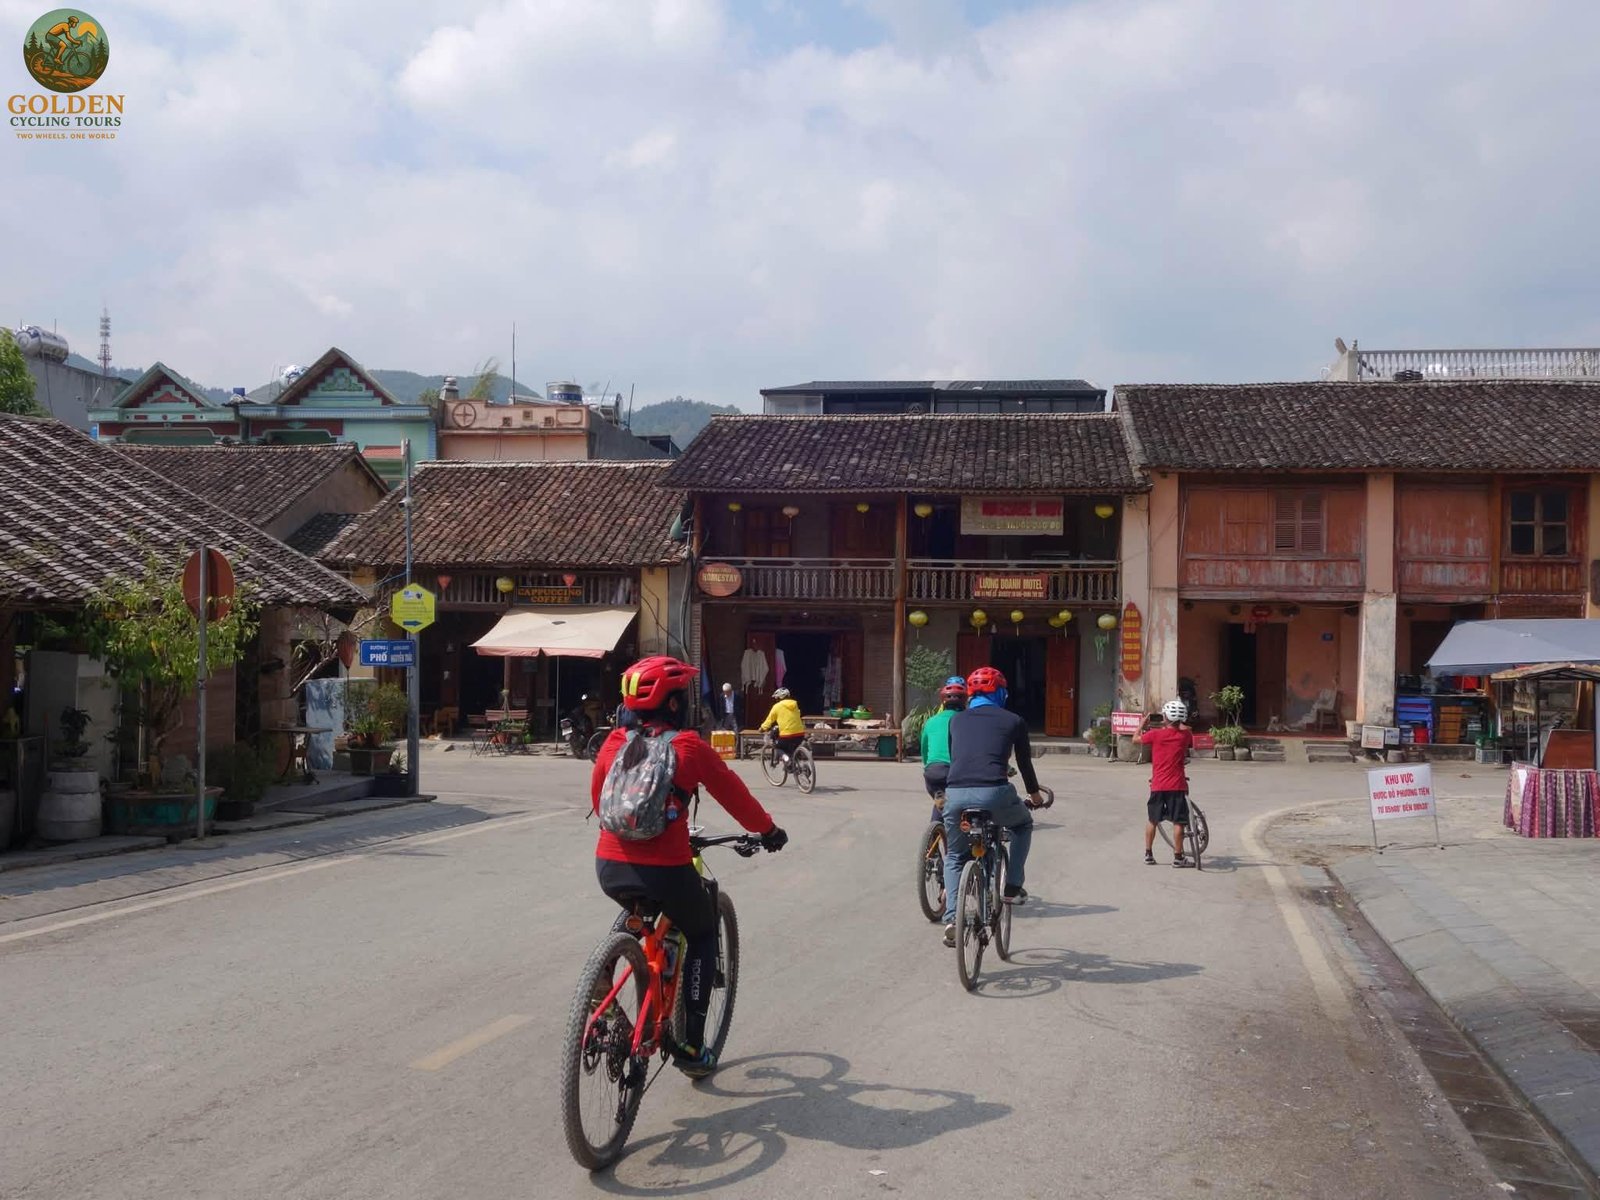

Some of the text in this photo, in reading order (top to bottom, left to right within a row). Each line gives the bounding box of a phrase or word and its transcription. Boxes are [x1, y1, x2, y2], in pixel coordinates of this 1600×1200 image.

[703, 573, 738, 582] HOMESTAY
[1023, 579, 1043, 590] MOTEL
[517, 588, 582, 596] CAPPUCCINO
[369, 651, 388, 662] PHỐ
[1384, 773, 1414, 785] KHU VỰC
